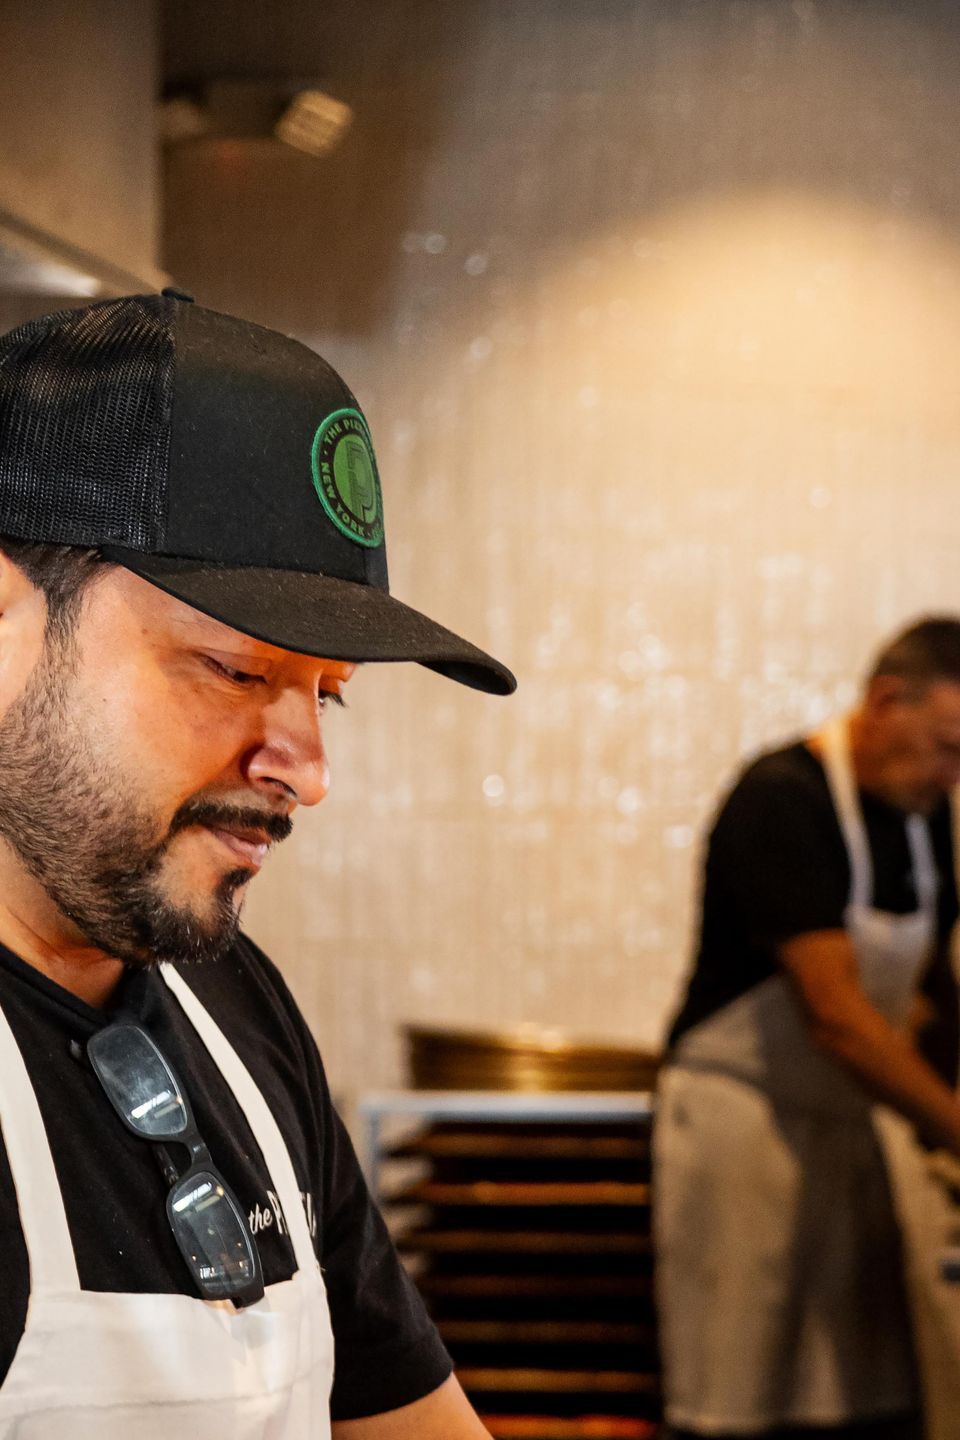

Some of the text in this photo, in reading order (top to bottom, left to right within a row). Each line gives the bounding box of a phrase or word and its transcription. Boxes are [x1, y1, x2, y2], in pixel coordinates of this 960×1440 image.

[324, 423, 342, 445] THE
[320, 462, 336, 498] NEW
[336, 503, 364, 536] YORK
[248, 1203, 272, 1235] the
